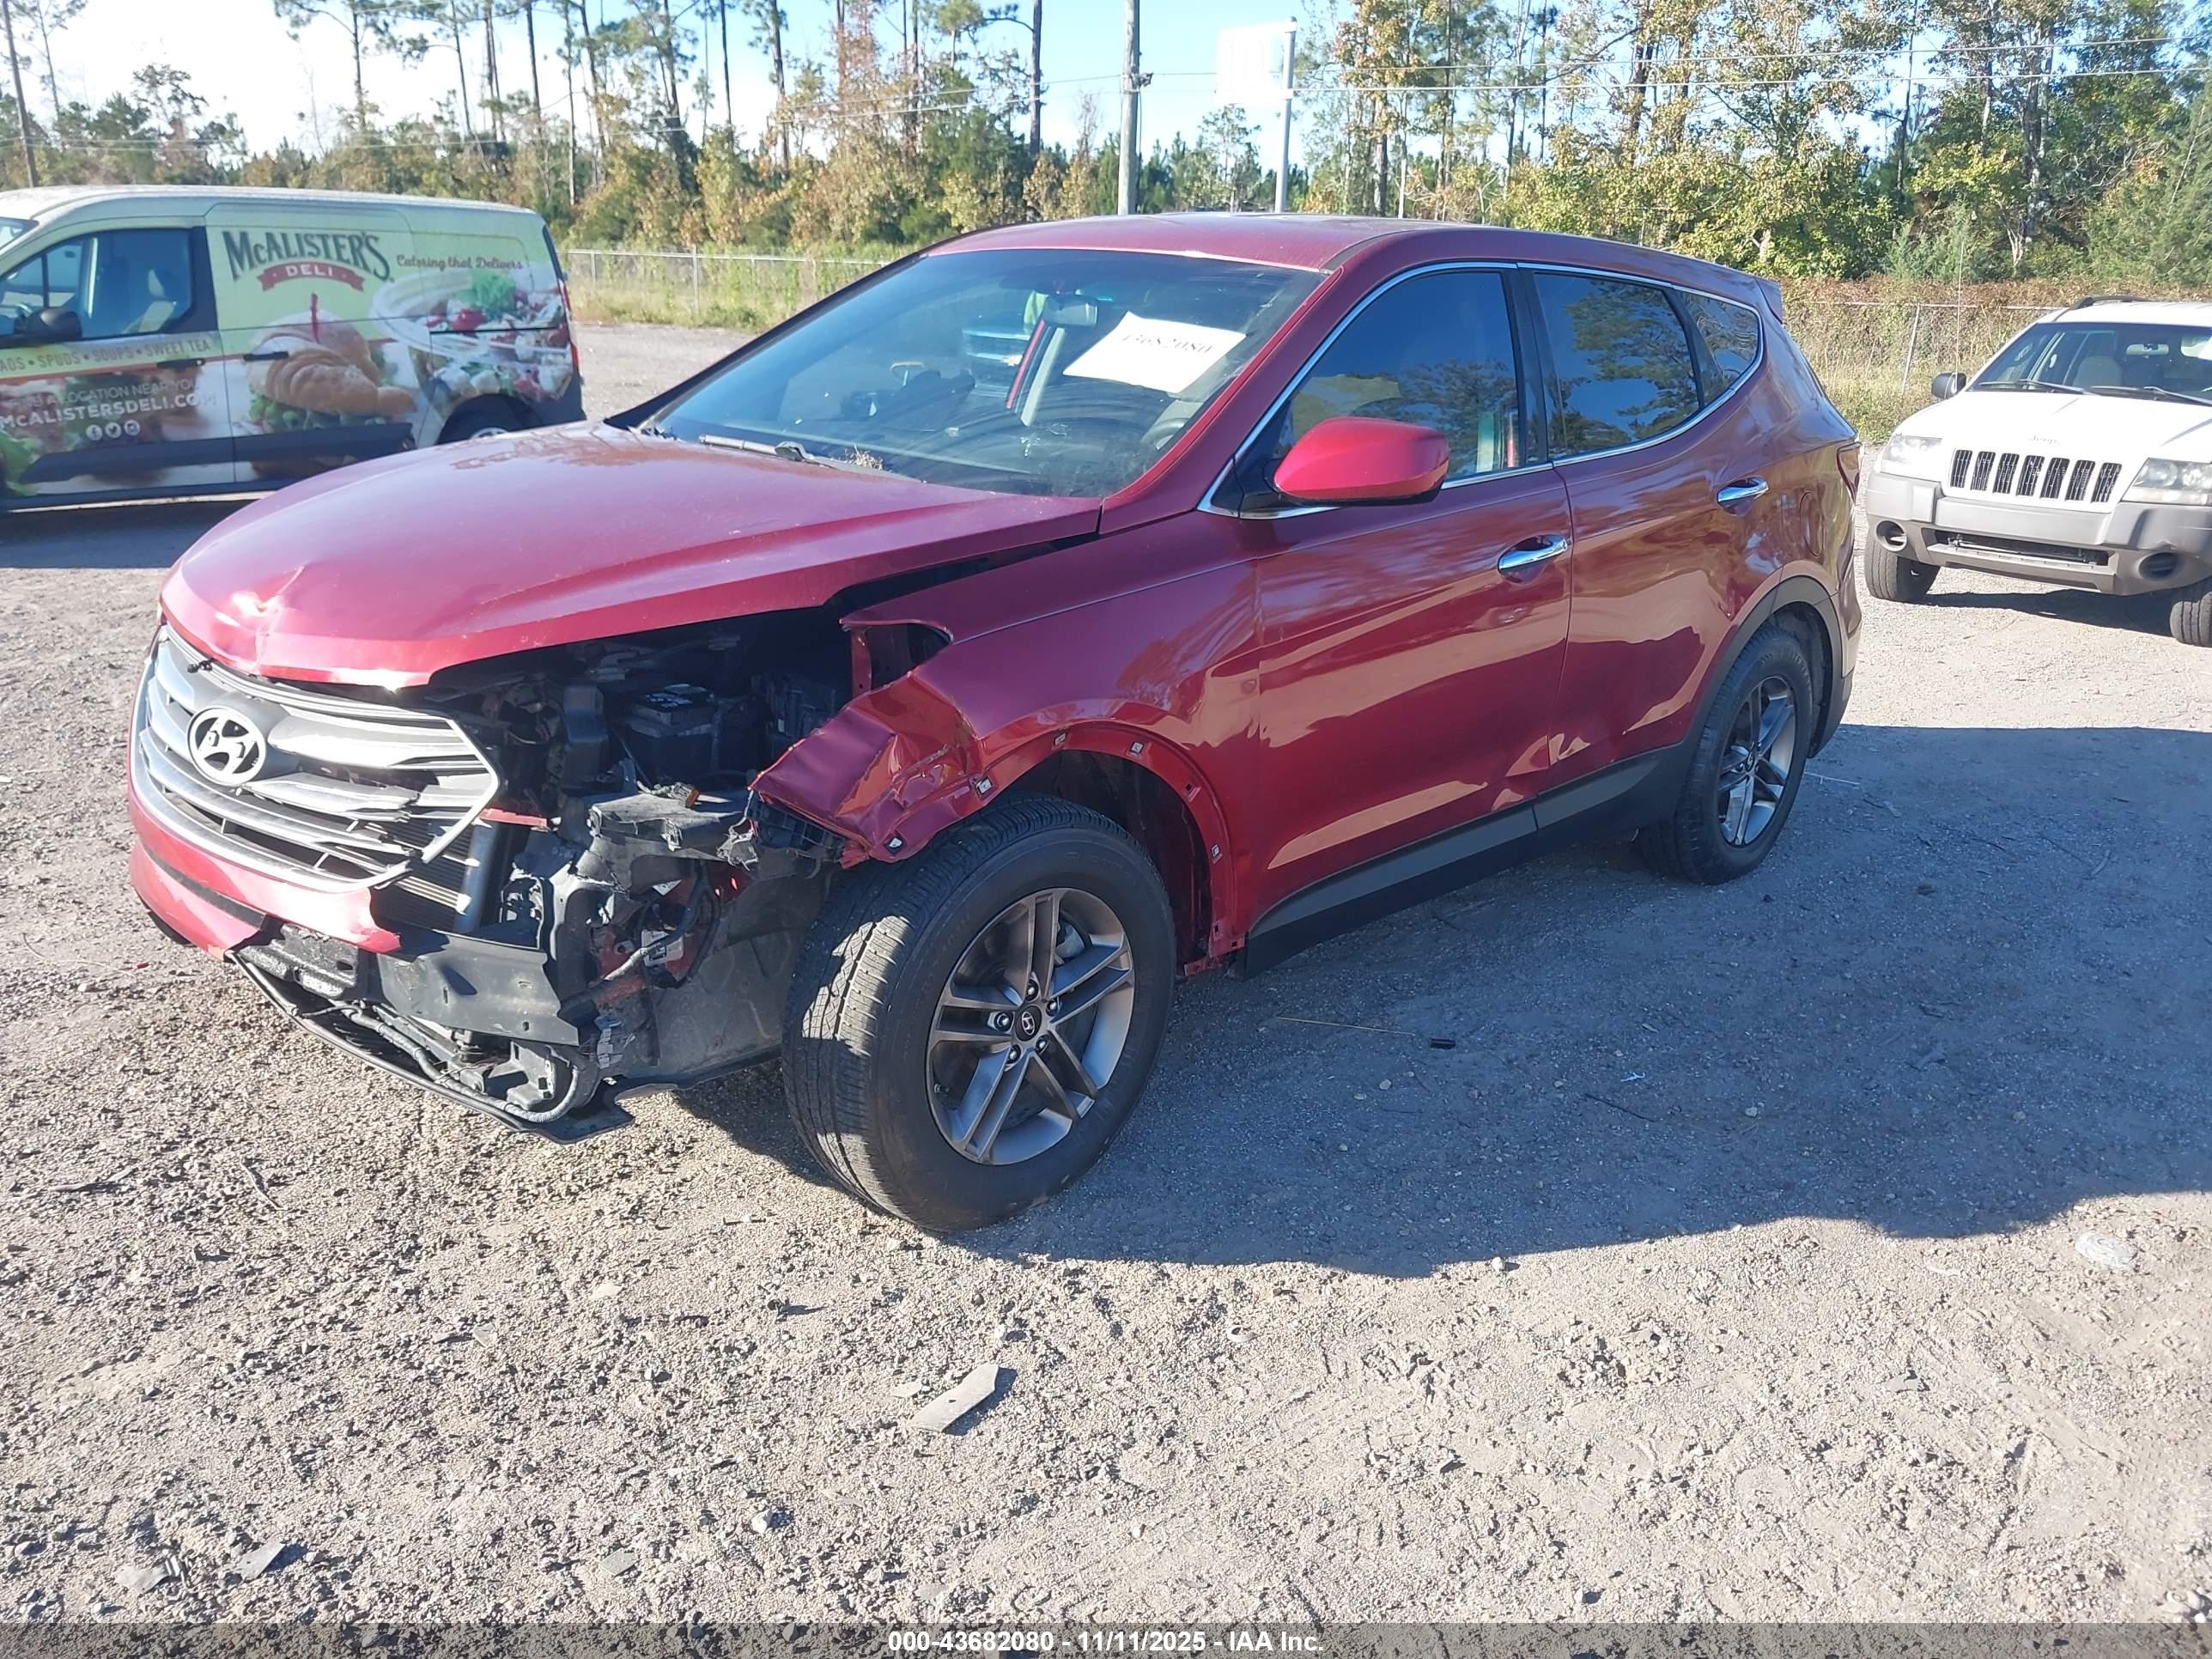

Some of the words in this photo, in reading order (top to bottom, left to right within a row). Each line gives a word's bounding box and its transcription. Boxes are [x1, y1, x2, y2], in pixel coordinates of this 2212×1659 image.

[285, 264, 334, 276] DELI
[396, 254, 446, 271] Catering
[447, 256, 472, 269] that
[475, 256, 524, 270] Delivers
[37, 352, 80, 368] SPUDS
[94, 347, 134, 363] SOUPS
[146, 341, 185, 357] SWEET
[189, 339, 212, 353] TEA
